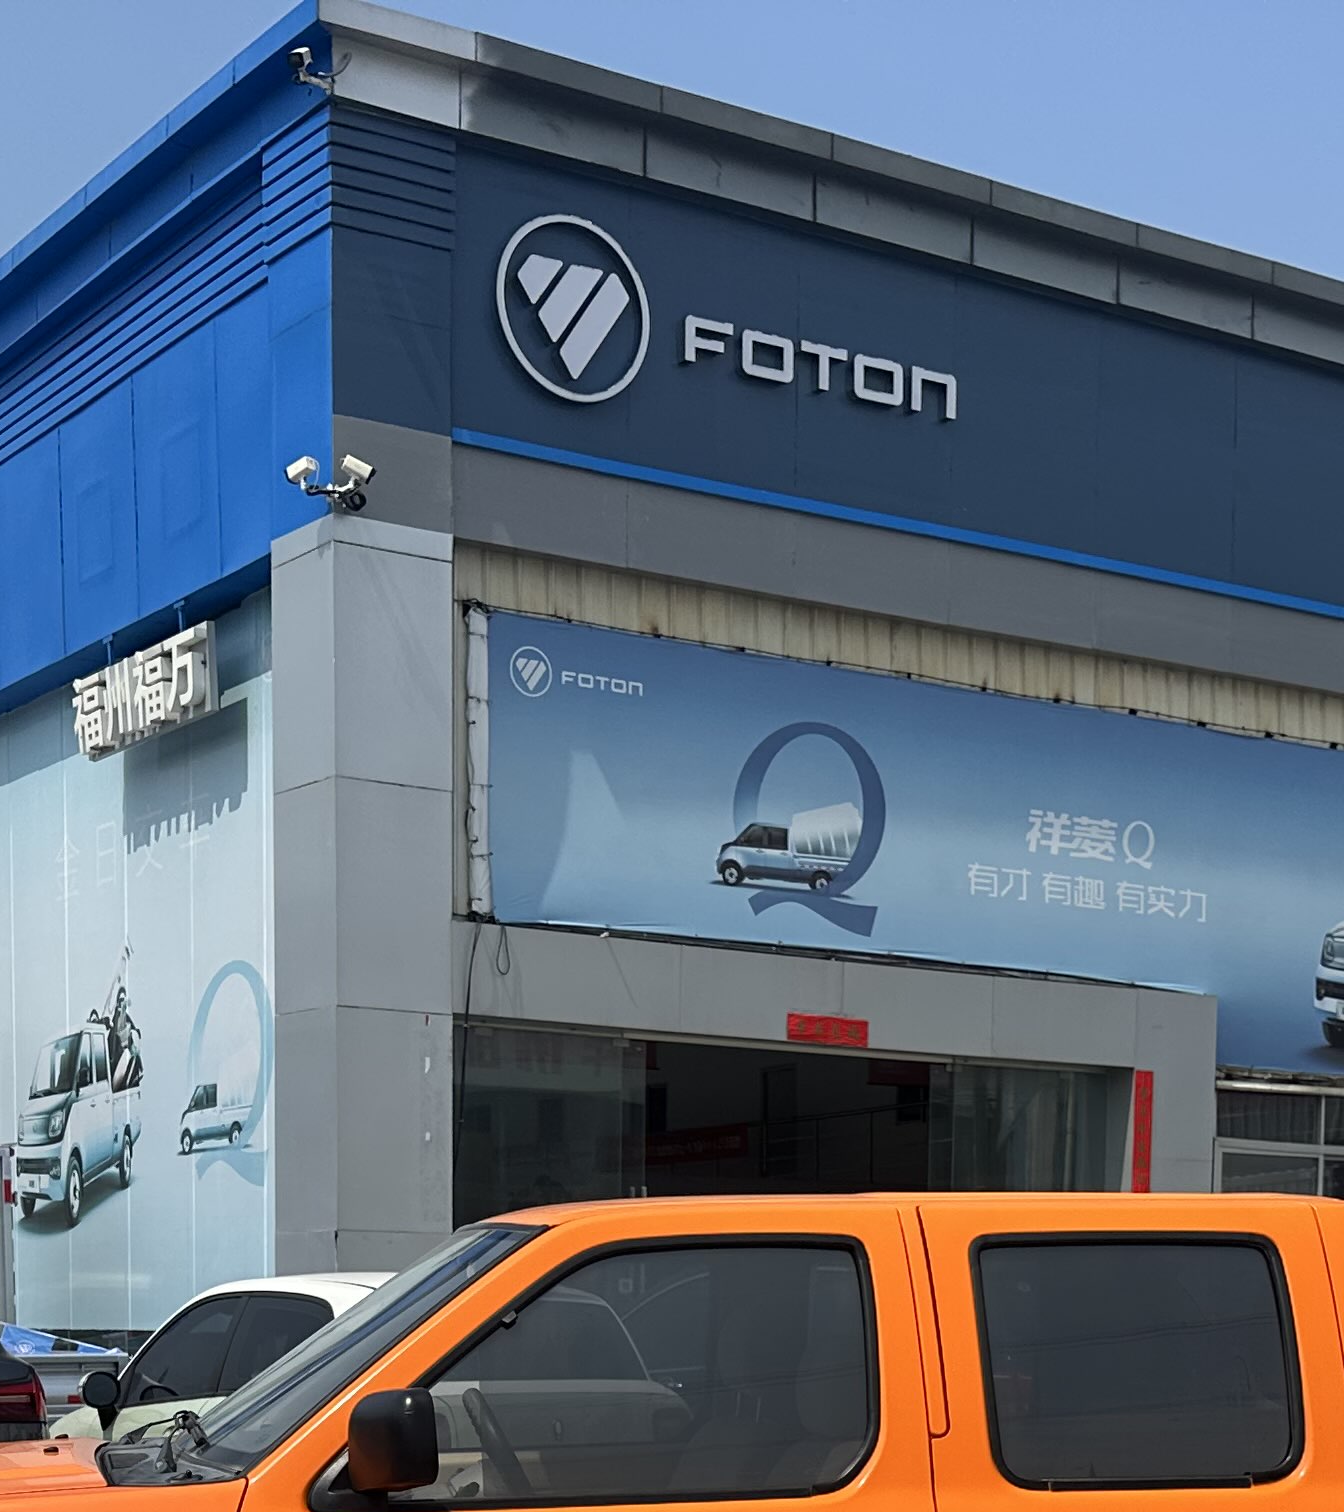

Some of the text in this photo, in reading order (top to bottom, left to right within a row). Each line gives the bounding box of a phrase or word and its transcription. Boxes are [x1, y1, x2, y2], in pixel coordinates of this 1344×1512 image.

[684, 314, 957, 420] FOTON
[72, 627, 204, 756] 福州福万
[561, 669, 644, 697] FOTON
[967, 862, 1208, 924] 有才 有趣 有实力
